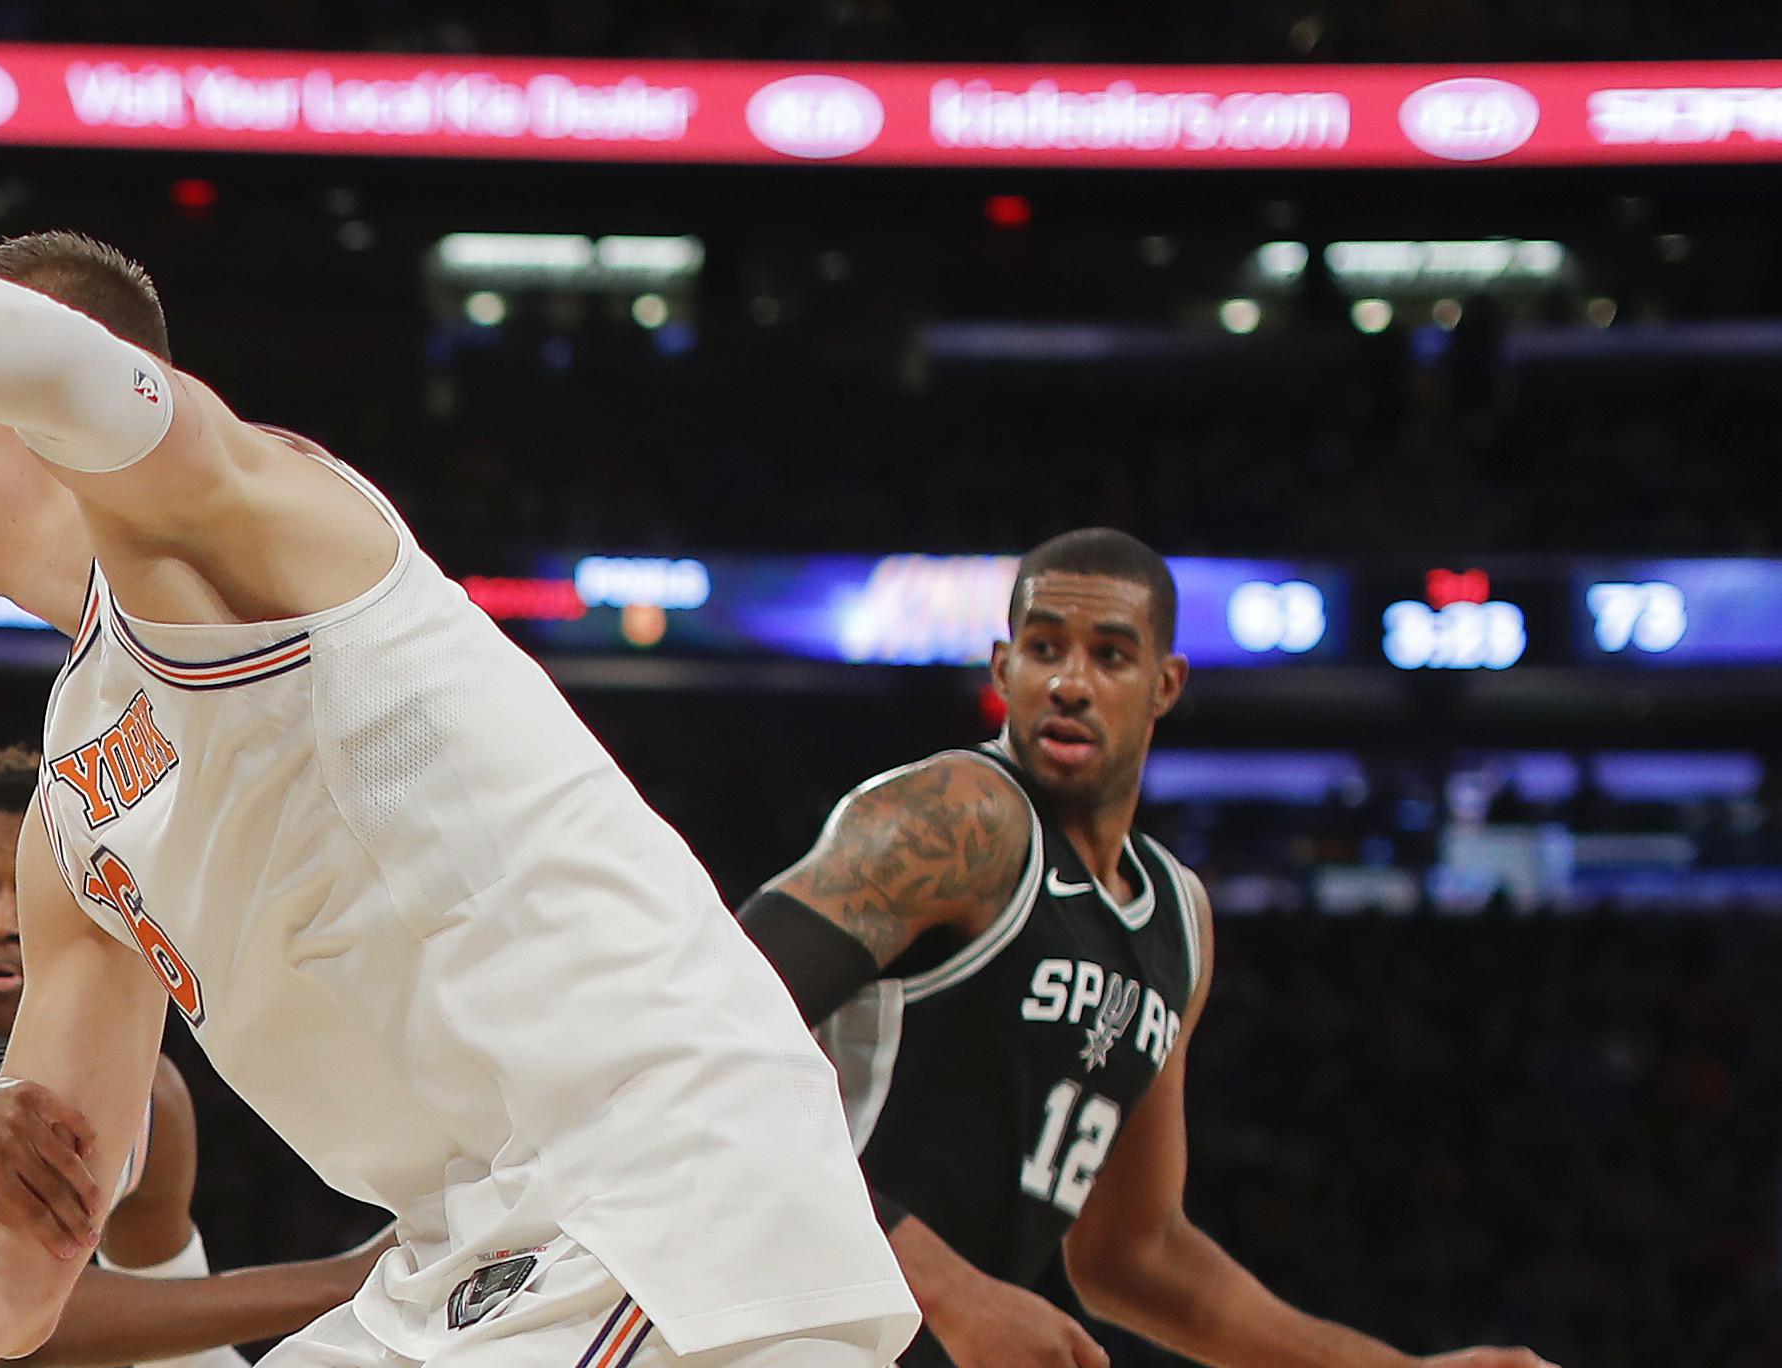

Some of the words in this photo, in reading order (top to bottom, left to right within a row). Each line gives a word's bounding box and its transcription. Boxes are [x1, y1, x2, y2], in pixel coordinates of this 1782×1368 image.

[67, 63, 186, 127] Visit
[190, 68, 300, 131] Your
[304, 71, 436, 133] Local
[445, 73, 527, 136] Kia
[528, 76, 696, 140] Dealer
[930, 80, 1351, 150] kiadealers.com
[49, 689, 180, 830] YORK
[1020, 1077, 1121, 1218] 12
